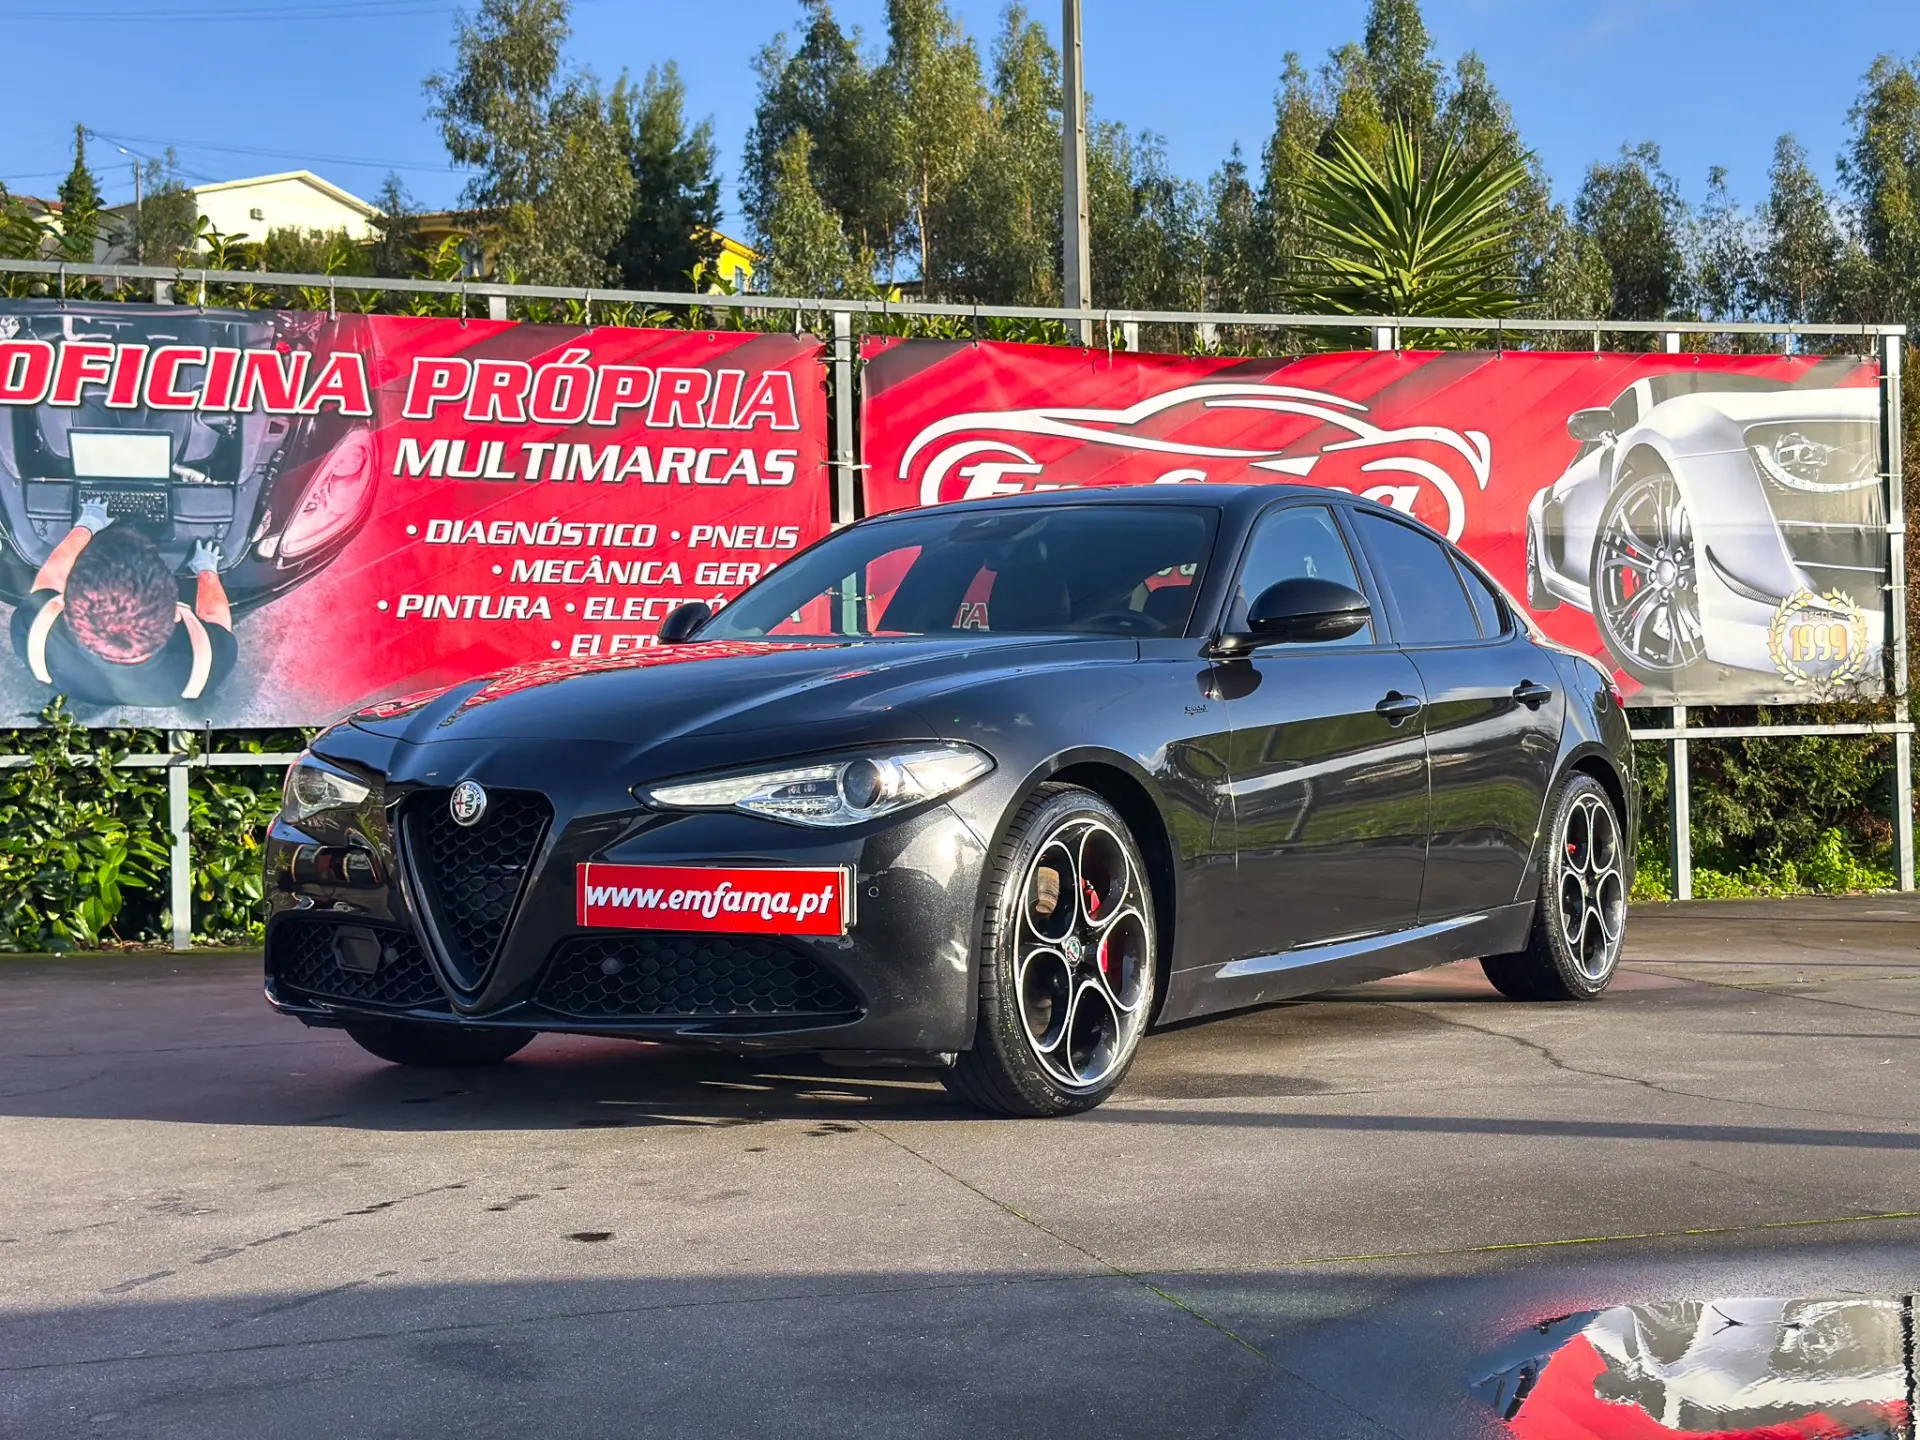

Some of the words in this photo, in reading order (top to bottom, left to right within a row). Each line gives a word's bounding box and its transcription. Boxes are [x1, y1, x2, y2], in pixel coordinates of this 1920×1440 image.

[0, 341, 373, 416] OFICINA
[402, 348, 801, 431] PRÓPRIA
[392, 438, 798, 487] MULTIMARCAS
[425, 516, 658, 549] DIAGNÓSTICO
[688, 525, 799, 550] PNEUS
[510, 555, 683, 586] MECÂNICA
[396, 595, 552, 621] PINTURA
[1790, 624, 1848, 662] 1999
[587, 881, 833, 921] www.emfama.pt
